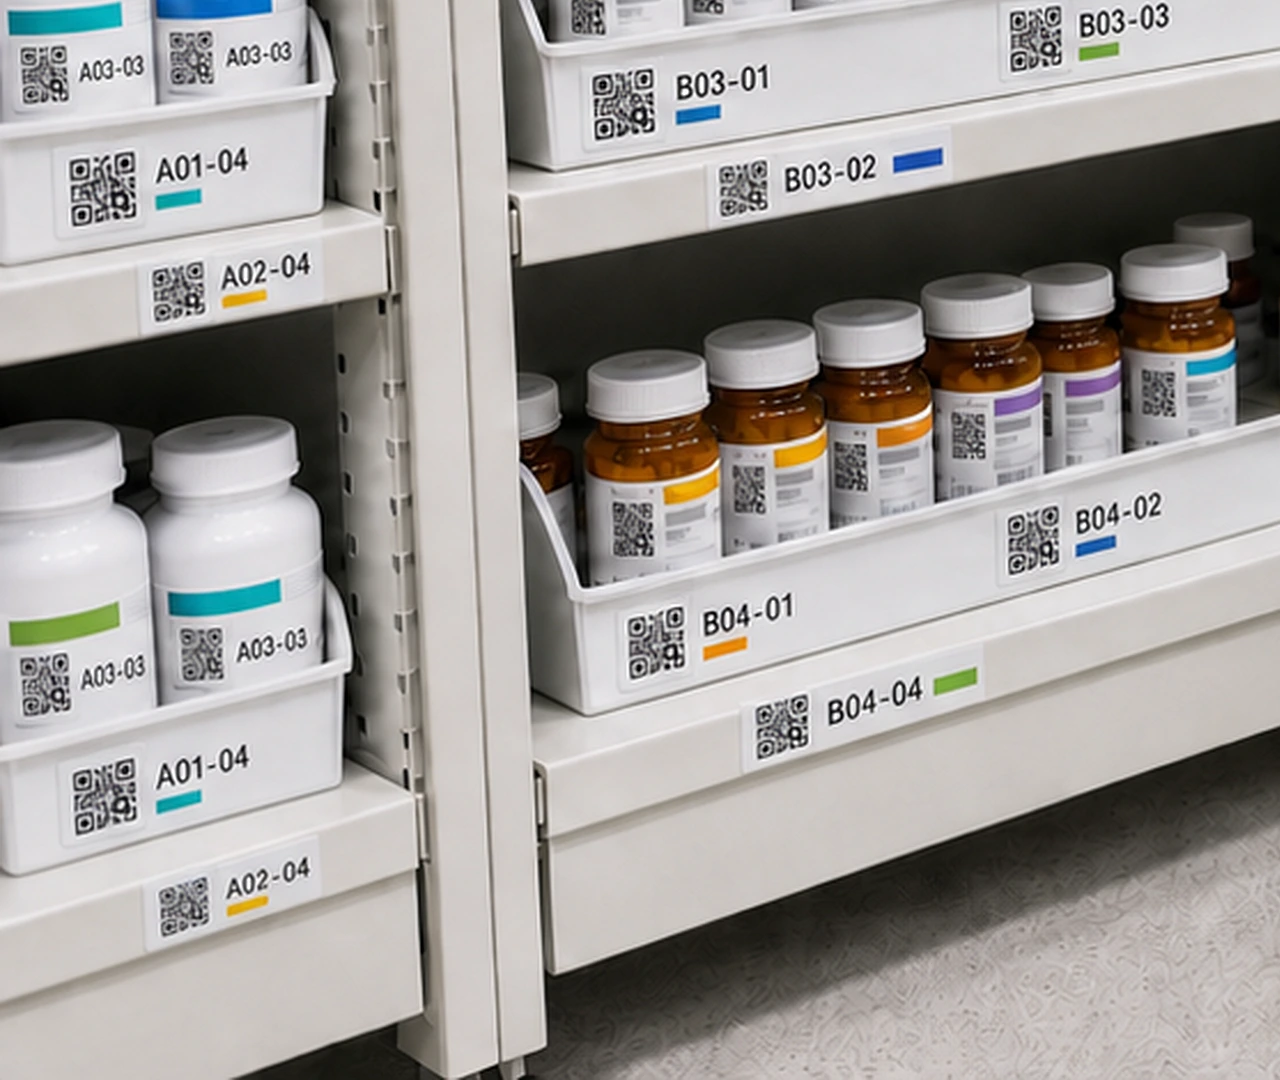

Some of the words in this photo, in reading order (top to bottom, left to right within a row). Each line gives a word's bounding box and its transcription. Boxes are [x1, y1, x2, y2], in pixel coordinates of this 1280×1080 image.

[1079, 2, 1170, 38] B03-03
[79, 54, 145, 83] A03-03
[226, 40, 293, 67] A03-03
[676, 64, 768, 101] B03-01
[155, 147, 248, 184] A01-04
[784, 154, 876, 193] B03-02
[221, 251, 311, 291] A02-04
[1075, 491, 1162, 535] B04-02
[703, 592, 792, 637] B04-01
[236, 627, 308, 663] A03-03
[80, 654, 146, 691] A03-03
[827, 675, 923, 726] B04-04
[156, 744, 250, 790] A01-04
[226, 856, 310, 900] A02-04
